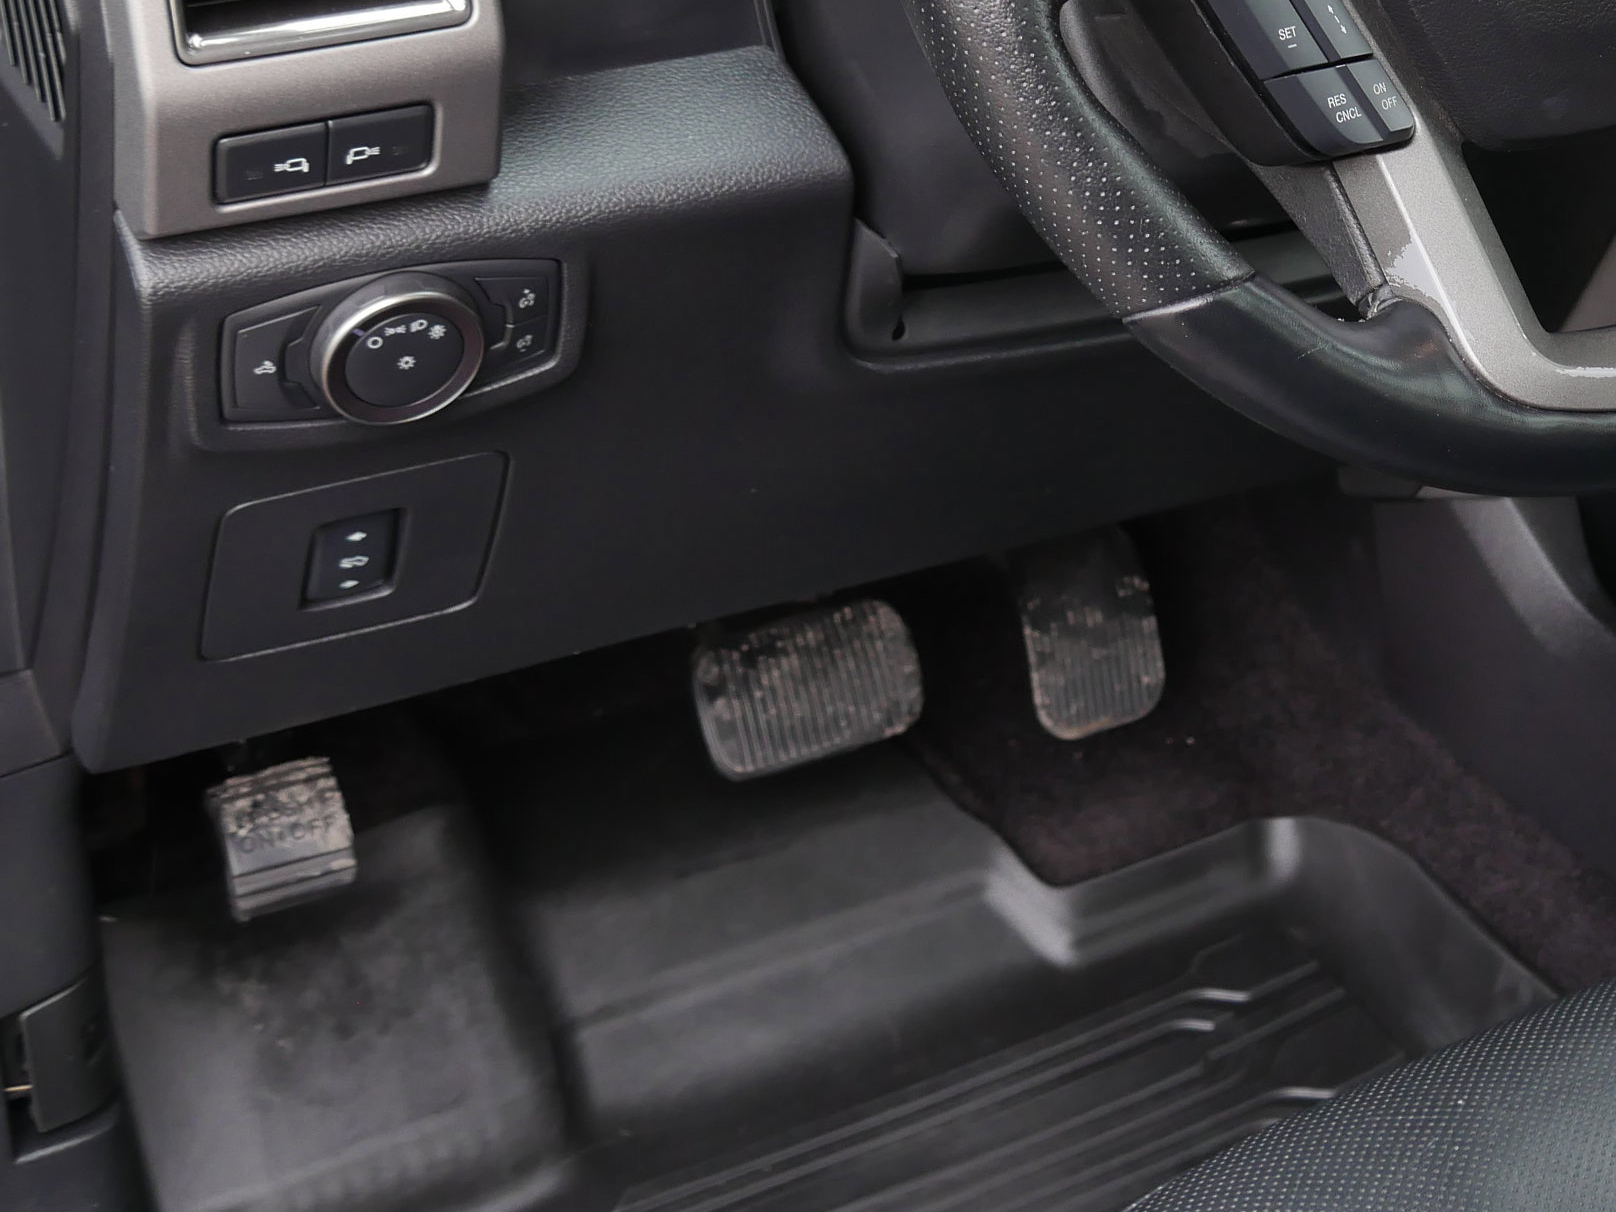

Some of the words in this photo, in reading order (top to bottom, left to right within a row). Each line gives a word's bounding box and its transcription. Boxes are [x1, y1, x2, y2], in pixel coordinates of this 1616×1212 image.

[1278, 26, 1296, 41] SET
[1373, 83, 1387, 95] ON
[1327, 94, 1347, 108] RES
[1381, 96, 1398, 110] OFF
[1336, 106, 1362, 124] CNCL
